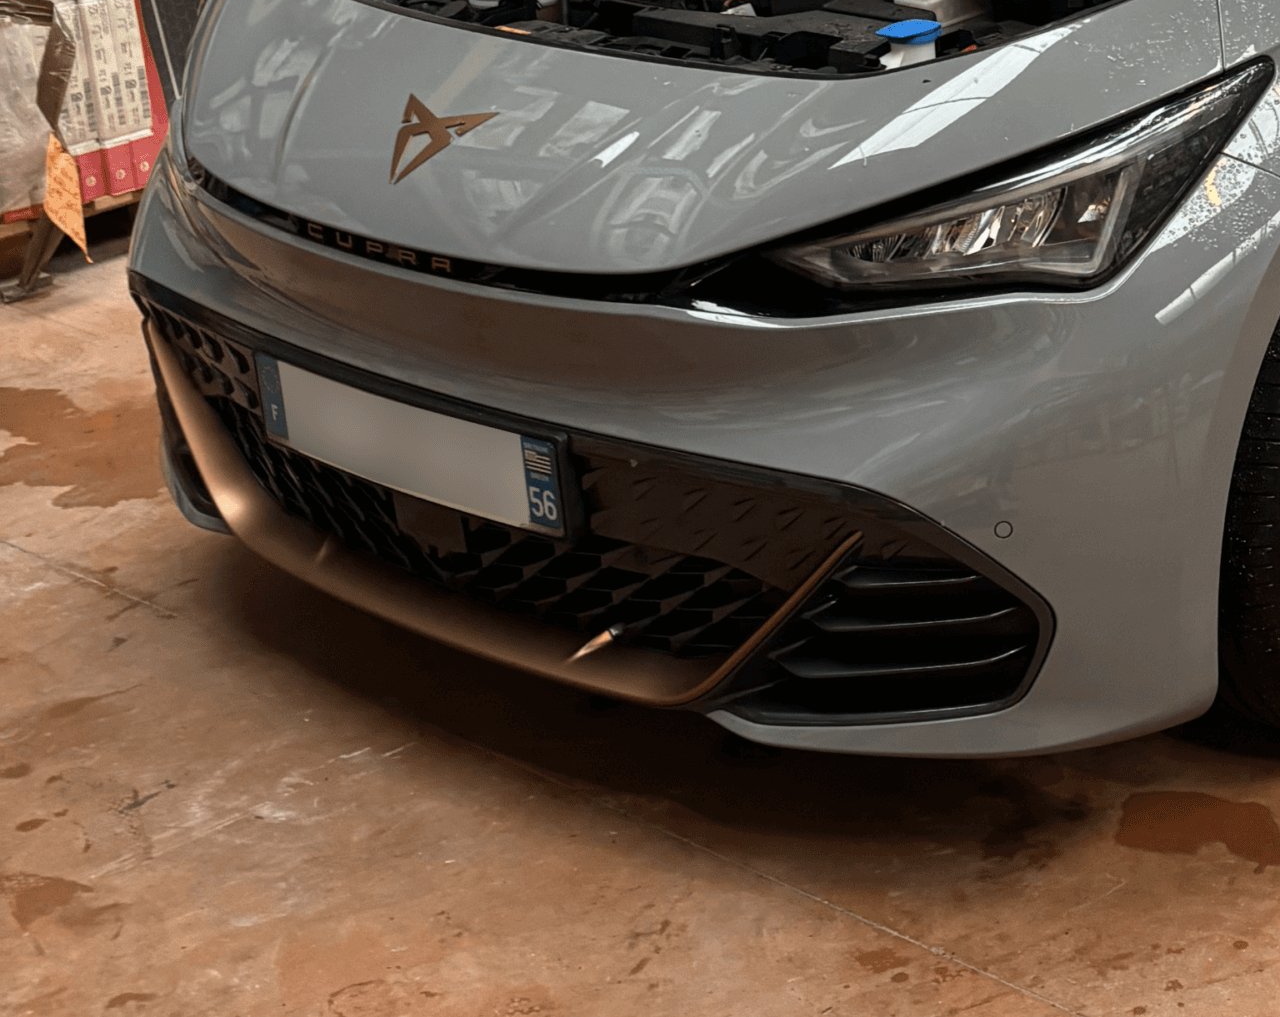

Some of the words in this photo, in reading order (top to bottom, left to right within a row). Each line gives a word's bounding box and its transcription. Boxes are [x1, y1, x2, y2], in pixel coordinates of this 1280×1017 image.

[307, 222, 452, 273] CUPRA
[270, 403, 279, 421] F
[528, 486, 558, 521] 56
